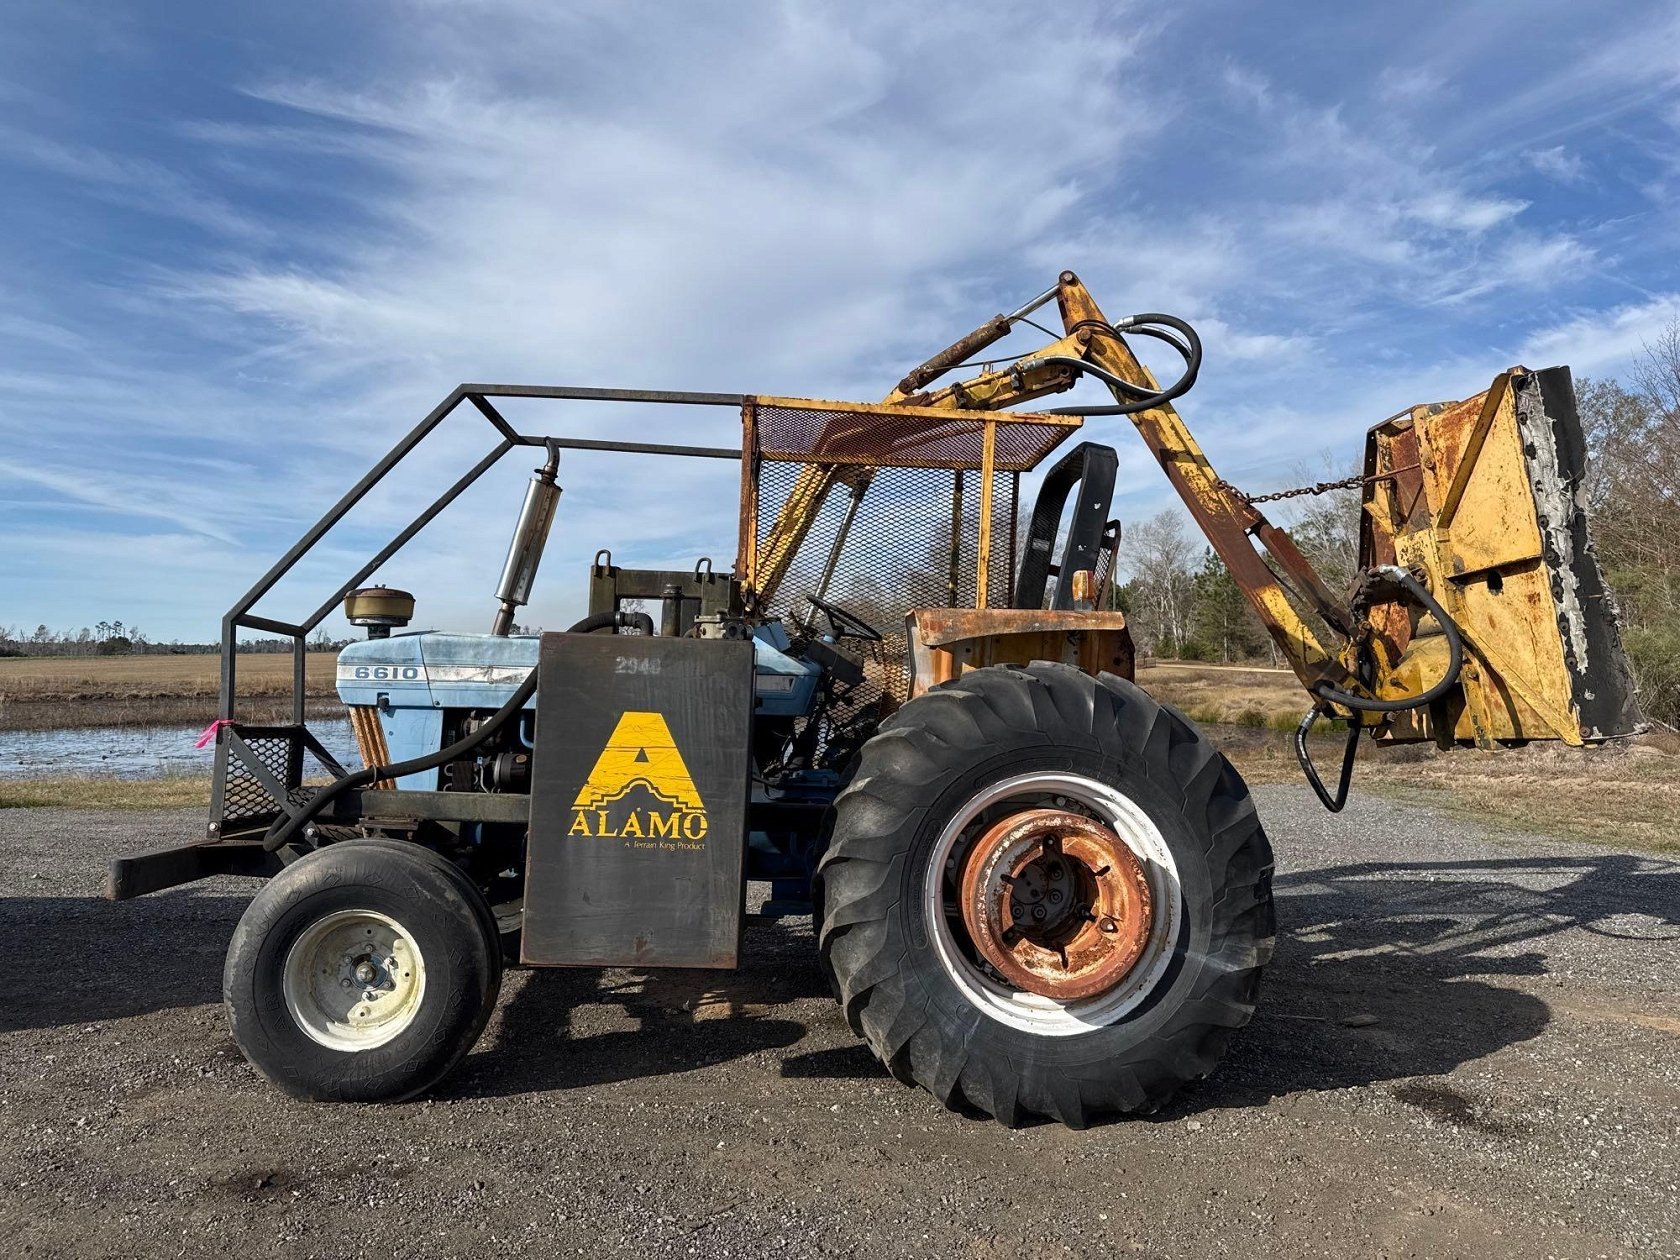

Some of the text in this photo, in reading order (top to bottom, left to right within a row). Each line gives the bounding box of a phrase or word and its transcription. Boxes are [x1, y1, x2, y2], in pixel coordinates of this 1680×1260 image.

[355, 666, 418, 679] 6610
[567, 809, 708, 840] ALAMO
[634, 840, 657, 849] Terrain
[659, 841, 676, 851] King
[677, 842, 705, 850] Product
